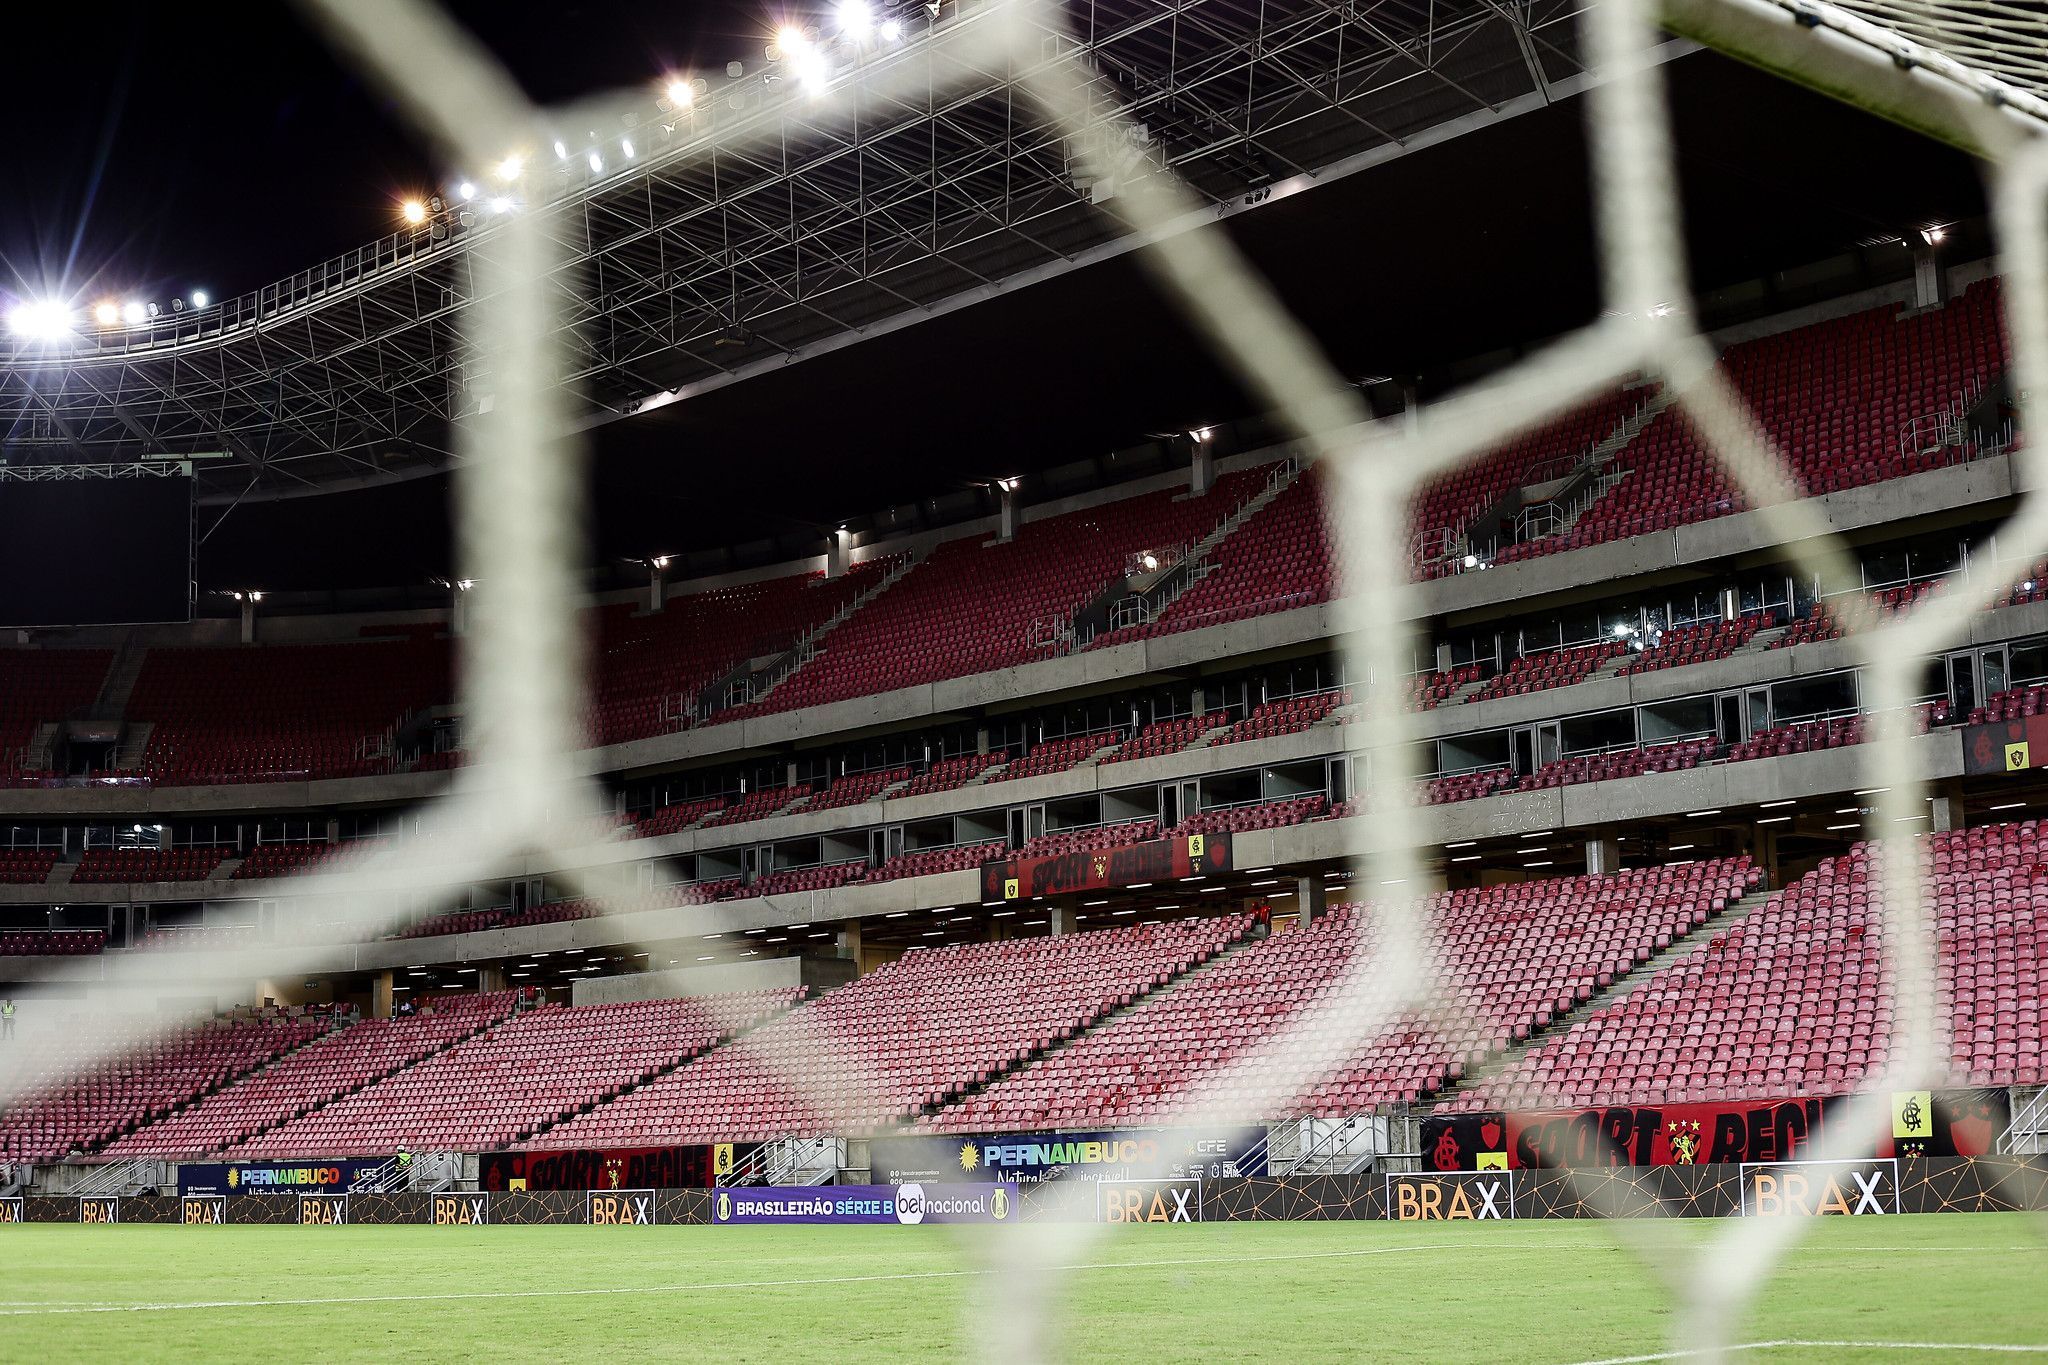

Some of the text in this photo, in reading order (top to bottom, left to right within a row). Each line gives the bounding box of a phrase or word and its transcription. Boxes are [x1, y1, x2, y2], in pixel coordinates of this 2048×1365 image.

[1032, 851, 1091, 896] SPORT
[984, 1140, 1157, 1167] PERNAMBUCO
[1197, 1139, 1227, 1153] CFE
[241, 1167, 340, 1185] PERNAMBUCO
[1106, 1188, 1192, 1223] BRAX
[1398, 1181, 1502, 1220] BRAX
[1754, 1171, 1885, 1216] BRAX
[0, 1202, 20, 1223] RAX
[83, 1202, 115, 1223] BRAX
[185, 1201, 222, 1224] BRAX
[303, 1201, 343, 1224] BRAX
[435, 1199, 483, 1225] BRAX
[592, 1197, 649, 1225] BRAX
[736, 1196, 894, 1216] BRASILEIRÃO SÉRIE B
